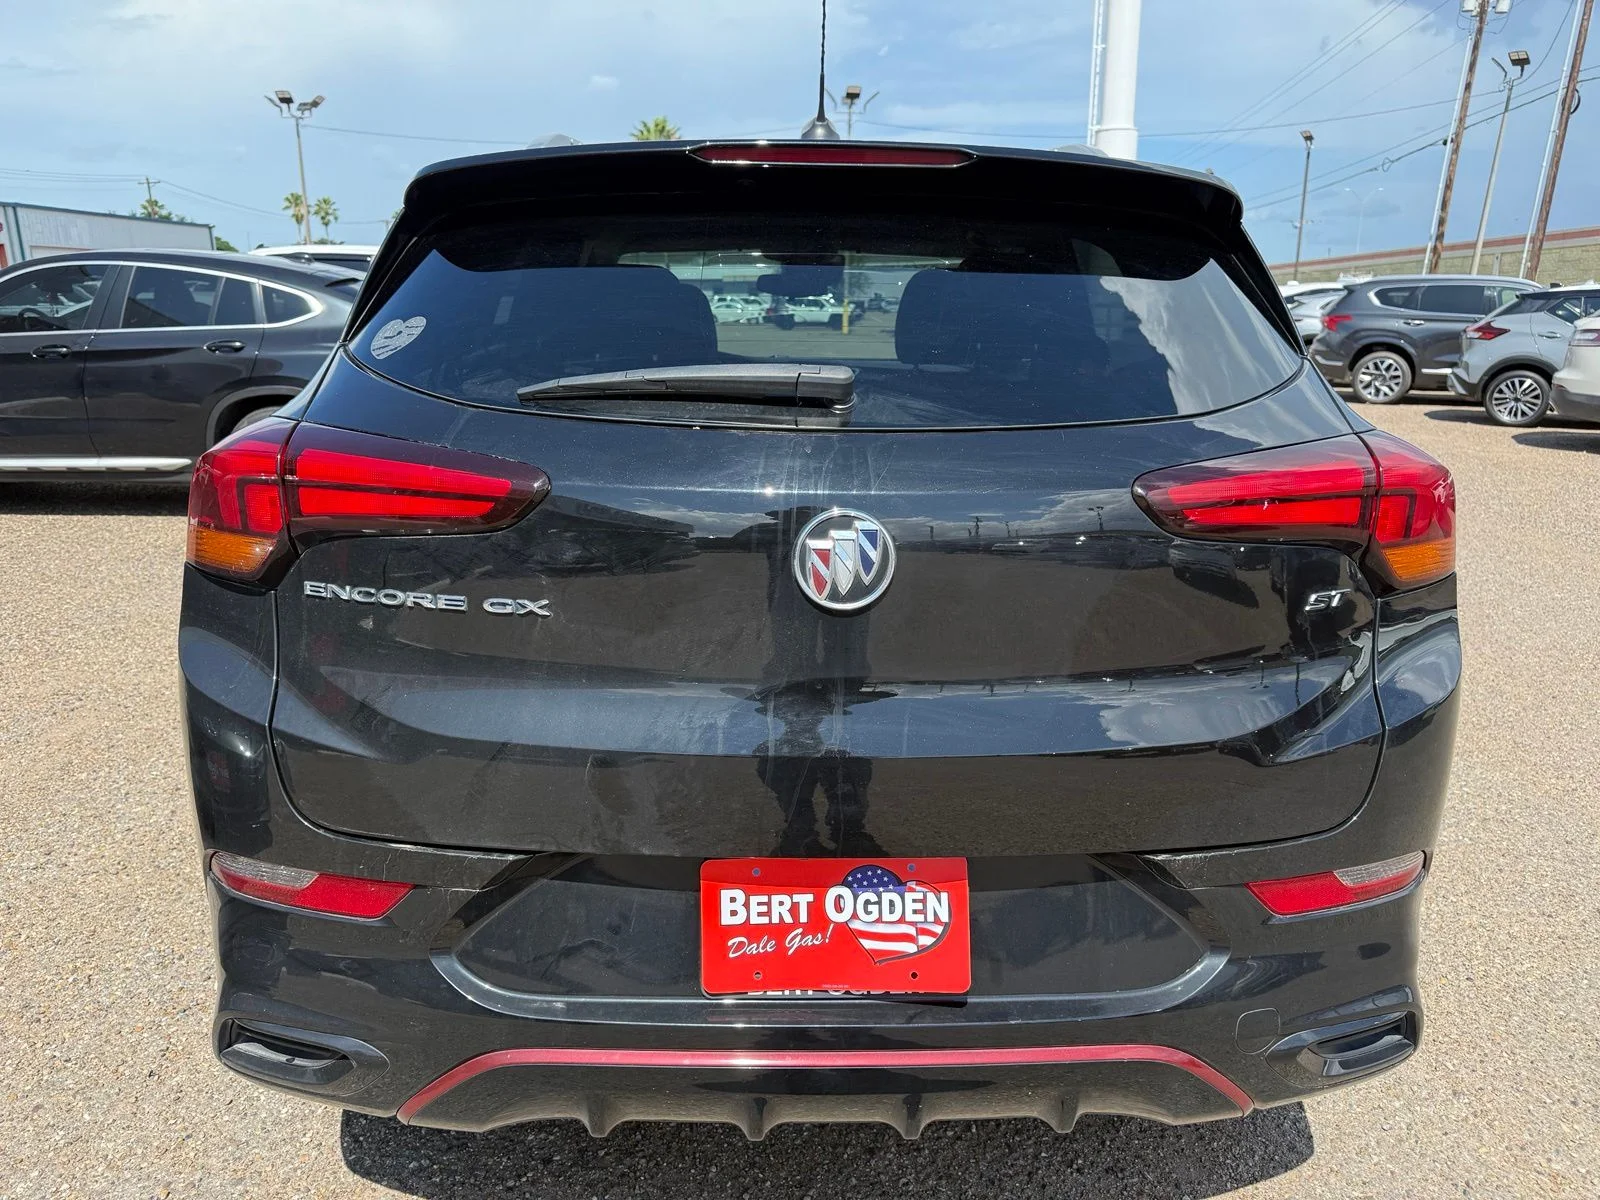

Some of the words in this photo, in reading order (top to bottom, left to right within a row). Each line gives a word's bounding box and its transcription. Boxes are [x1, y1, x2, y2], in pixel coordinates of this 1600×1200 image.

[303, 580, 468, 612] ENCORE
[482, 597, 553, 617] GX
[1304, 588, 1352, 613] ST
[720, 888, 814, 926] BERT
[824, 884, 950, 924] OGDEN
[727, 935, 776, 958] Dale
[785, 923, 834, 956] Gas!
